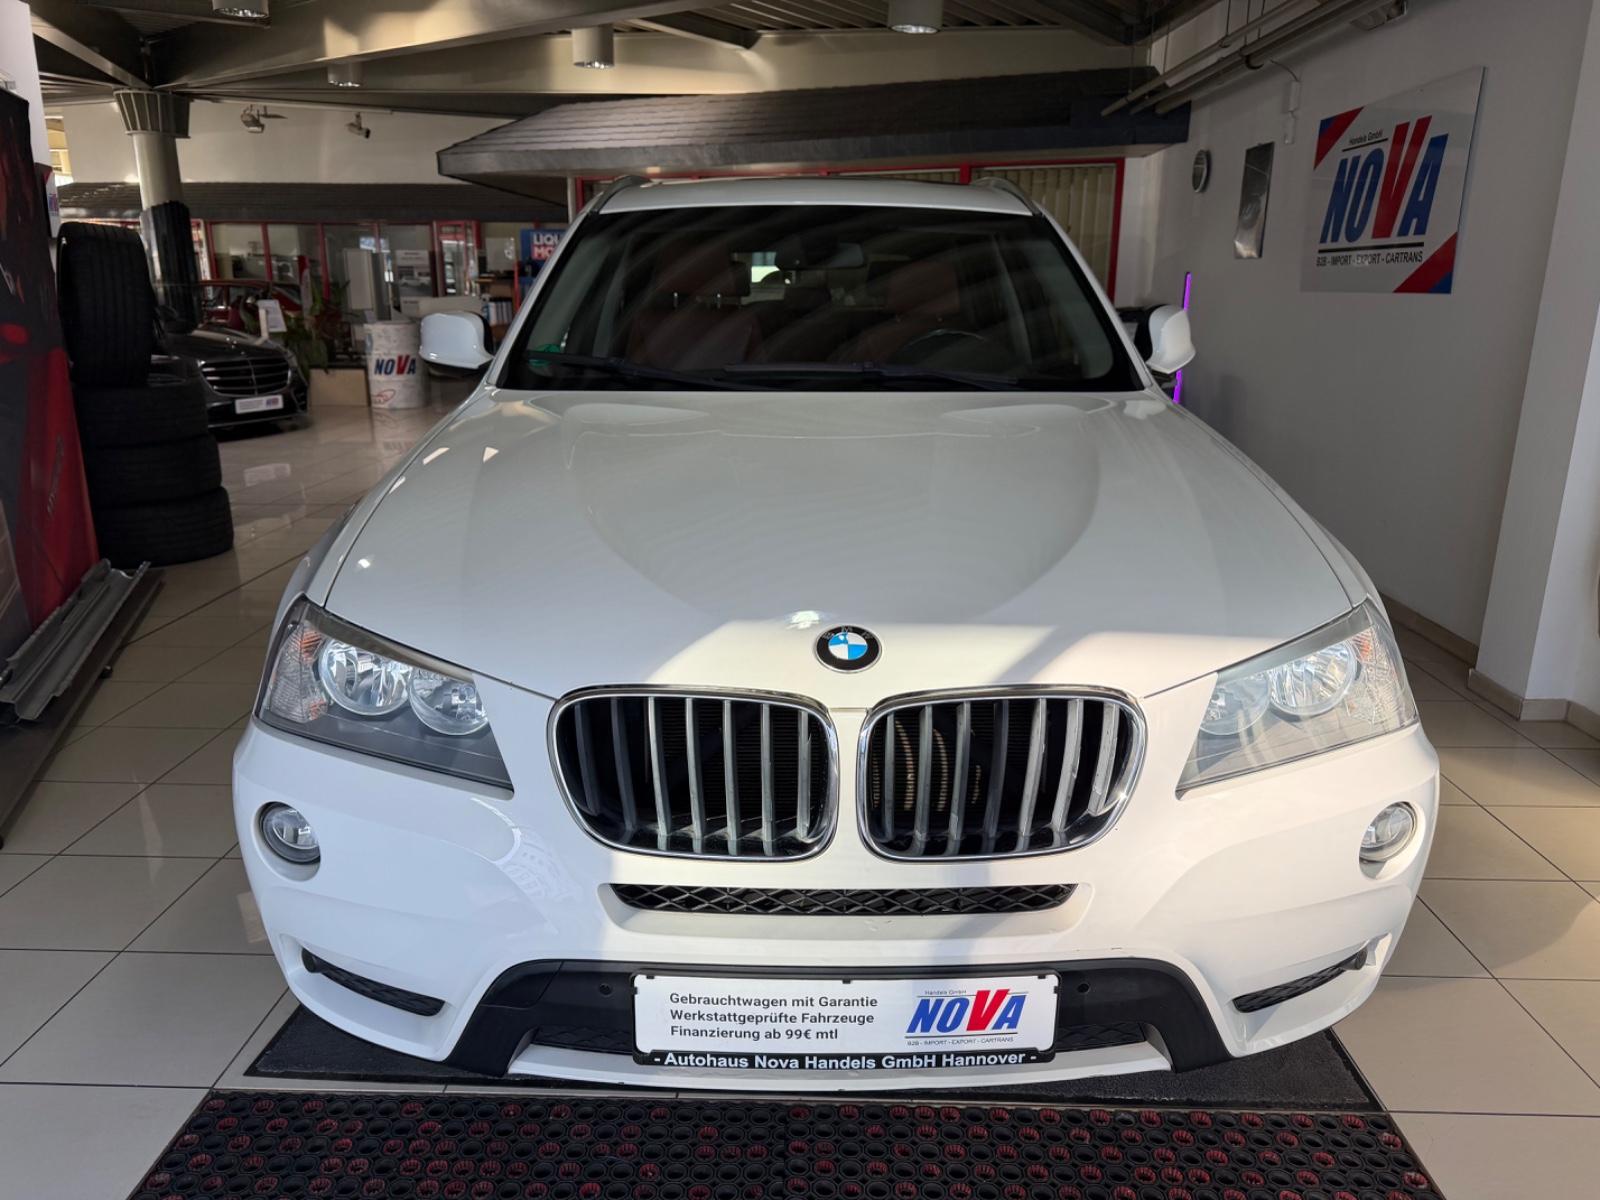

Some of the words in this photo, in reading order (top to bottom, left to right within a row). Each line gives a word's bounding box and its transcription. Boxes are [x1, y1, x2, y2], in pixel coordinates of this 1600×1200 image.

[1319, 115, 1449, 244] NOVA
[533, 231, 563, 245] LIQU
[1330, 254, 1352, 266] IMPORT
[1356, 253, 1381, 265] EXPORT
[1385, 250, 1424, 264] CARTRANS
[374, 354, 417, 375] NOVA
[669, 992, 788, 1009] Gebrauchtwagen
[791, 996, 814, 1007] mit
[818, 996, 878, 1007] Garantie
[670, 1009, 797, 1025] Werkstattgeprüfte
[801, 1012, 875, 1026] Fahrzeuge
[906, 988, 1027, 1033] NOVA
[670, 1025, 761, 1041] Finanzierung
[764, 1028, 781, 1040] ab
[785, 1028, 812, 1040] 99€
[816, 1028, 838, 1040] mtl
[664, 1052, 749, 1068] Autohaus
[754, 1055, 799, 1069] Nova
[805, 1055, 876, 1069] Handels
[881, 1054, 936, 1068] GmbH
[942, 1053, 1025, 1067] Hannover
